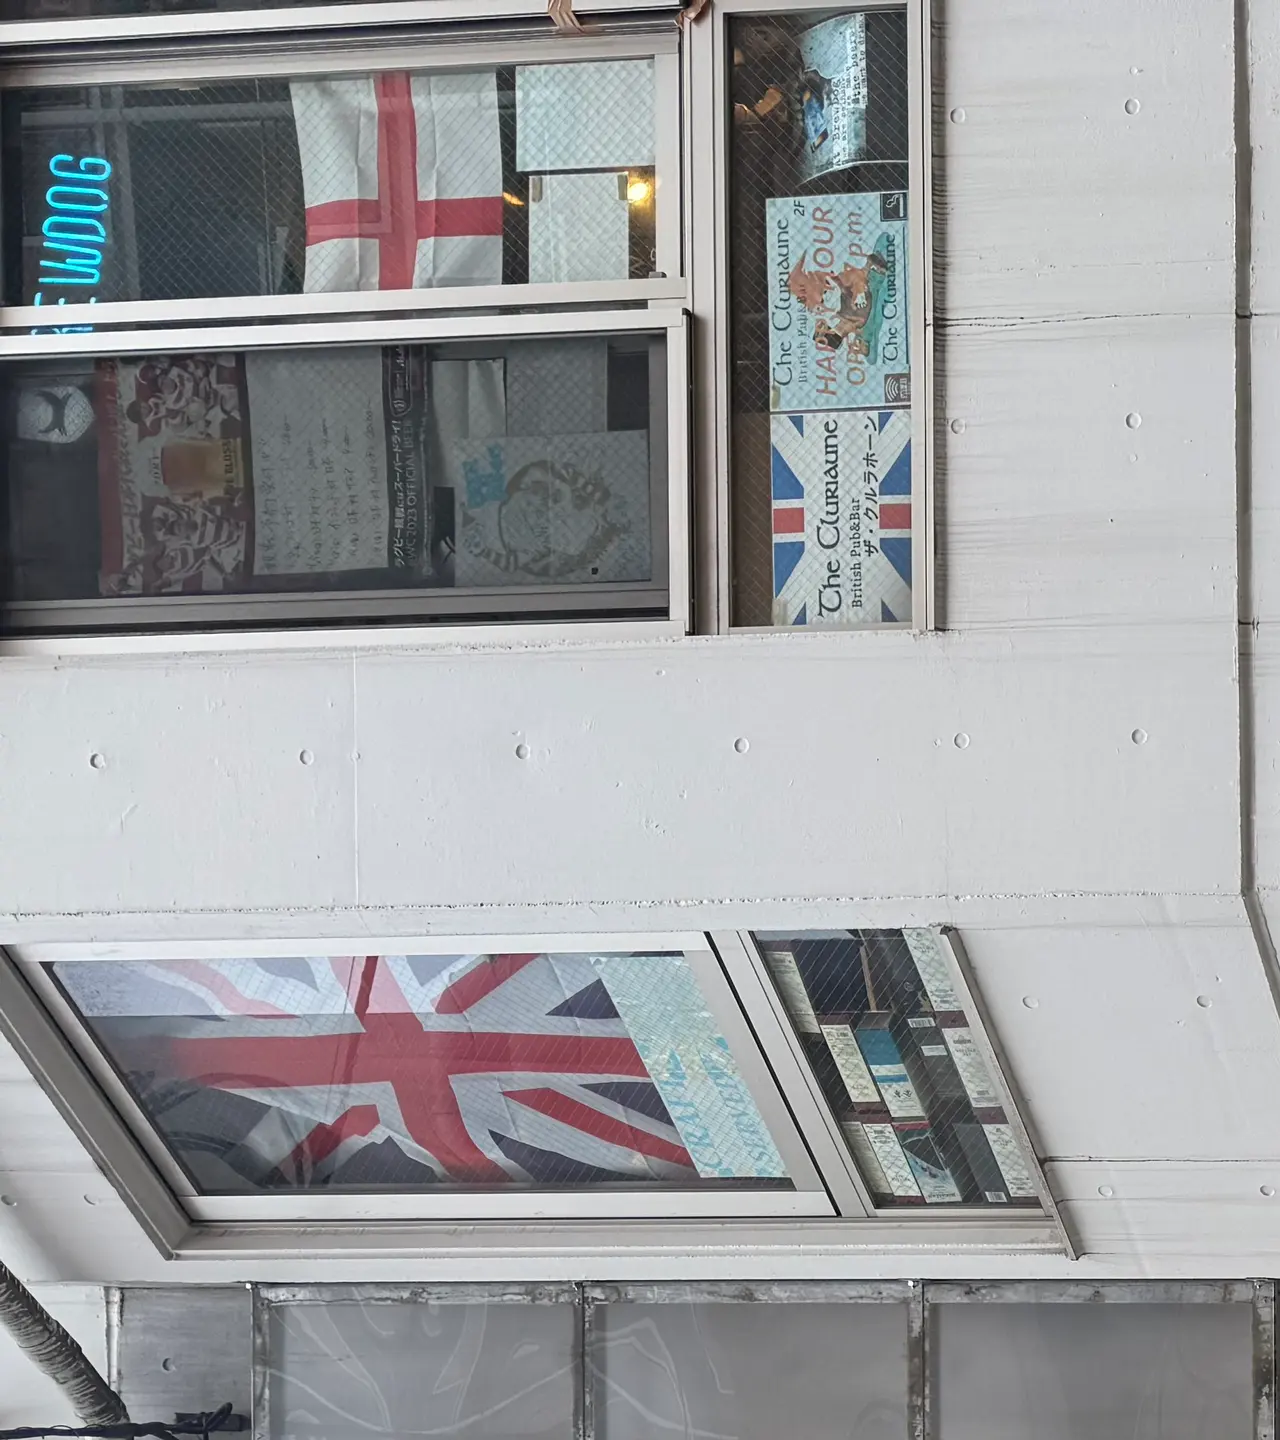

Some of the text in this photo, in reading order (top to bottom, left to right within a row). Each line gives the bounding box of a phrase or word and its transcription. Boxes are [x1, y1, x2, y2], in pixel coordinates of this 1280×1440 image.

[793, 199, 806, 217] 2F
[771, 339, 793, 386] The
[404, 452, 417, 505] OFFICIAL
[863, 415, 880, 557] ザ・クルラホーン
[406, 508, 417, 537] 2023
[848, 498, 862, 608] British Pub&Bar
[816, 560, 842, 618] The
